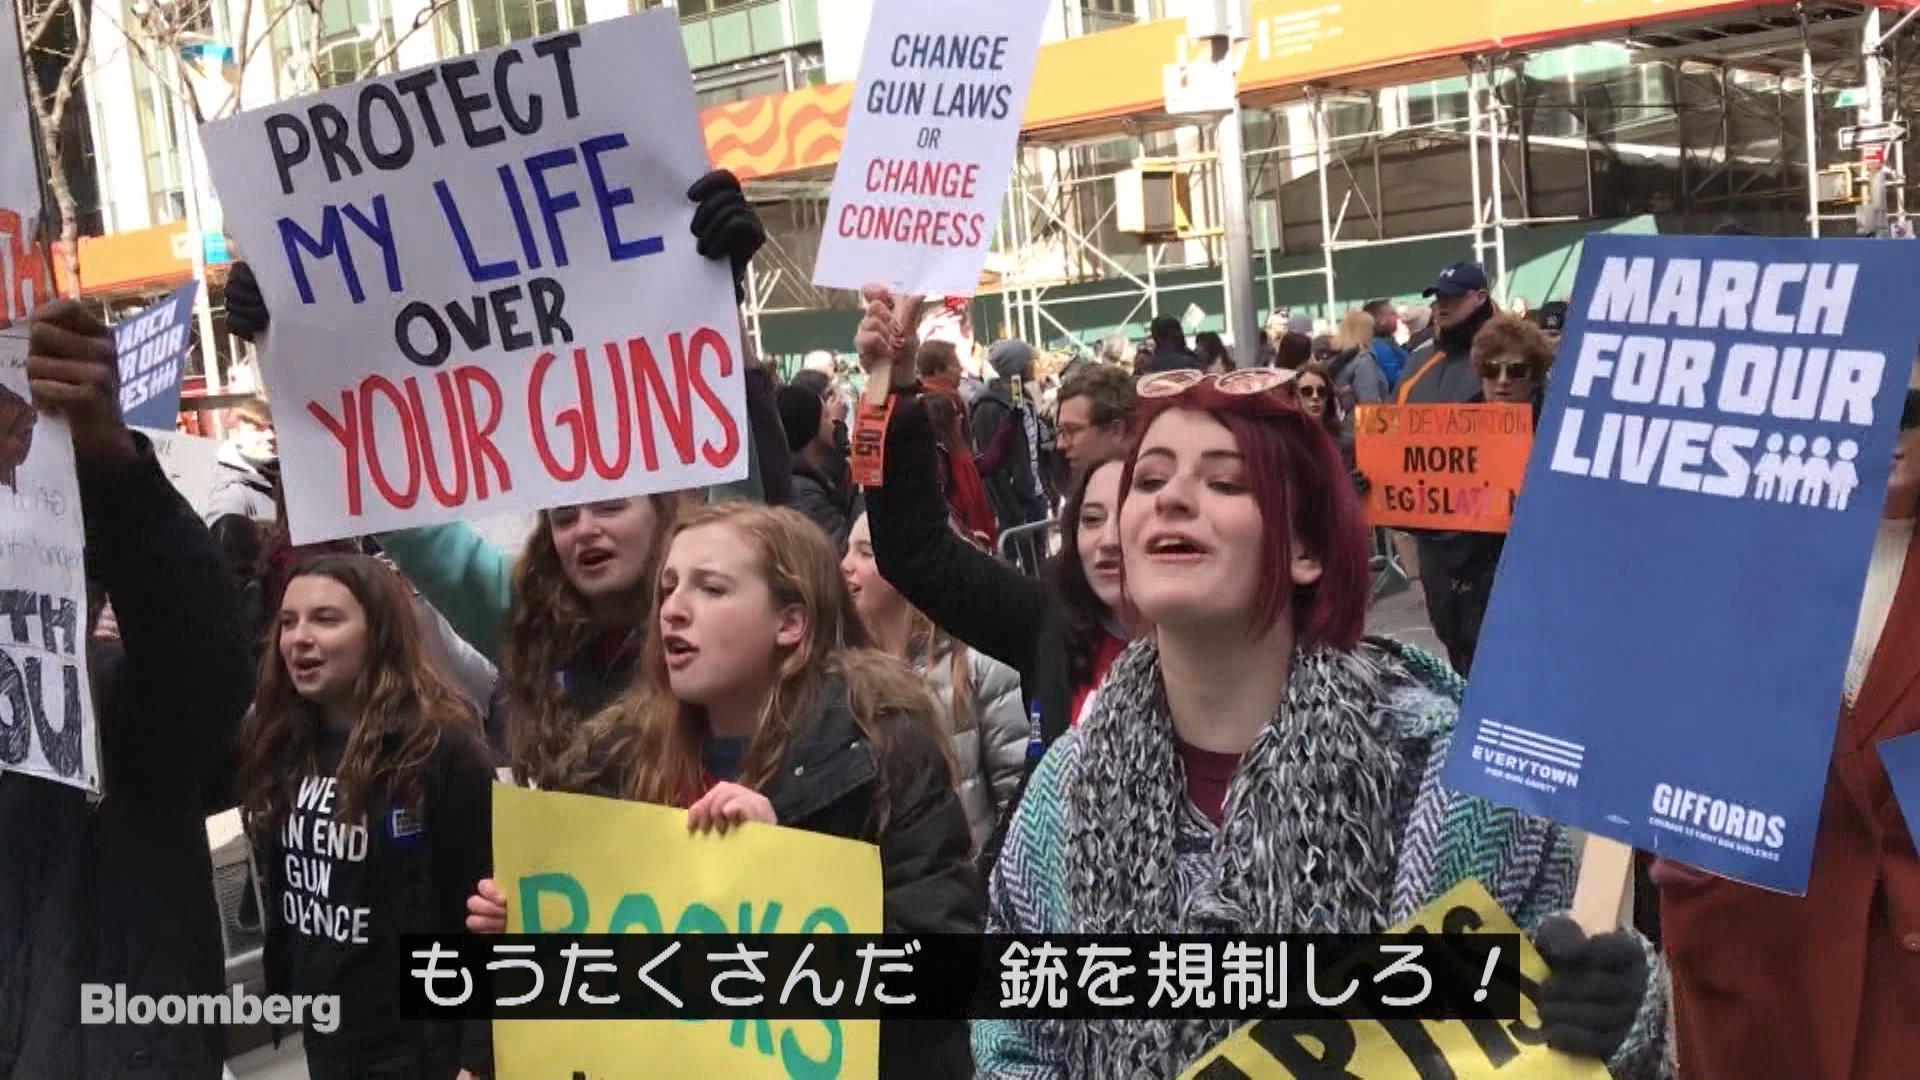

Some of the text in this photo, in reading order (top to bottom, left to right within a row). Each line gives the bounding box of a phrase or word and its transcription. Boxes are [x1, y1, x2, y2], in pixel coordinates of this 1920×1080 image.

[890, 34, 1009, 70] CHANGE
[264, 31, 582, 194] PROTECT
[866, 80, 1012, 120] GUN LAWS
[916, 127, 941, 149] OR
[865, 158, 980, 199] CHANGE
[277, 132, 664, 303] MY LIFE
[838, 203, 985, 248] CONGRESS
[1587, 256, 1859, 336] MARCH
[394, 276, 574, 367] OVER
[138, 323, 184, 373] OUR
[1569, 332, 1887, 426] FOR OUR
[306, 364, 513, 517] YOUR
[527, 326, 740, 482] GUNS
[1403, 445, 1479, 474] MORE
[1551, 407, 1760, 498] LIVES
[1472, 745, 1579, 788] EVERYTOWN
[297, 776, 338, 813] WE
[1652, 783, 1786, 848] GIFFORDS
[312, 817, 369, 862] END
[285, 853, 331, 898] GUN
